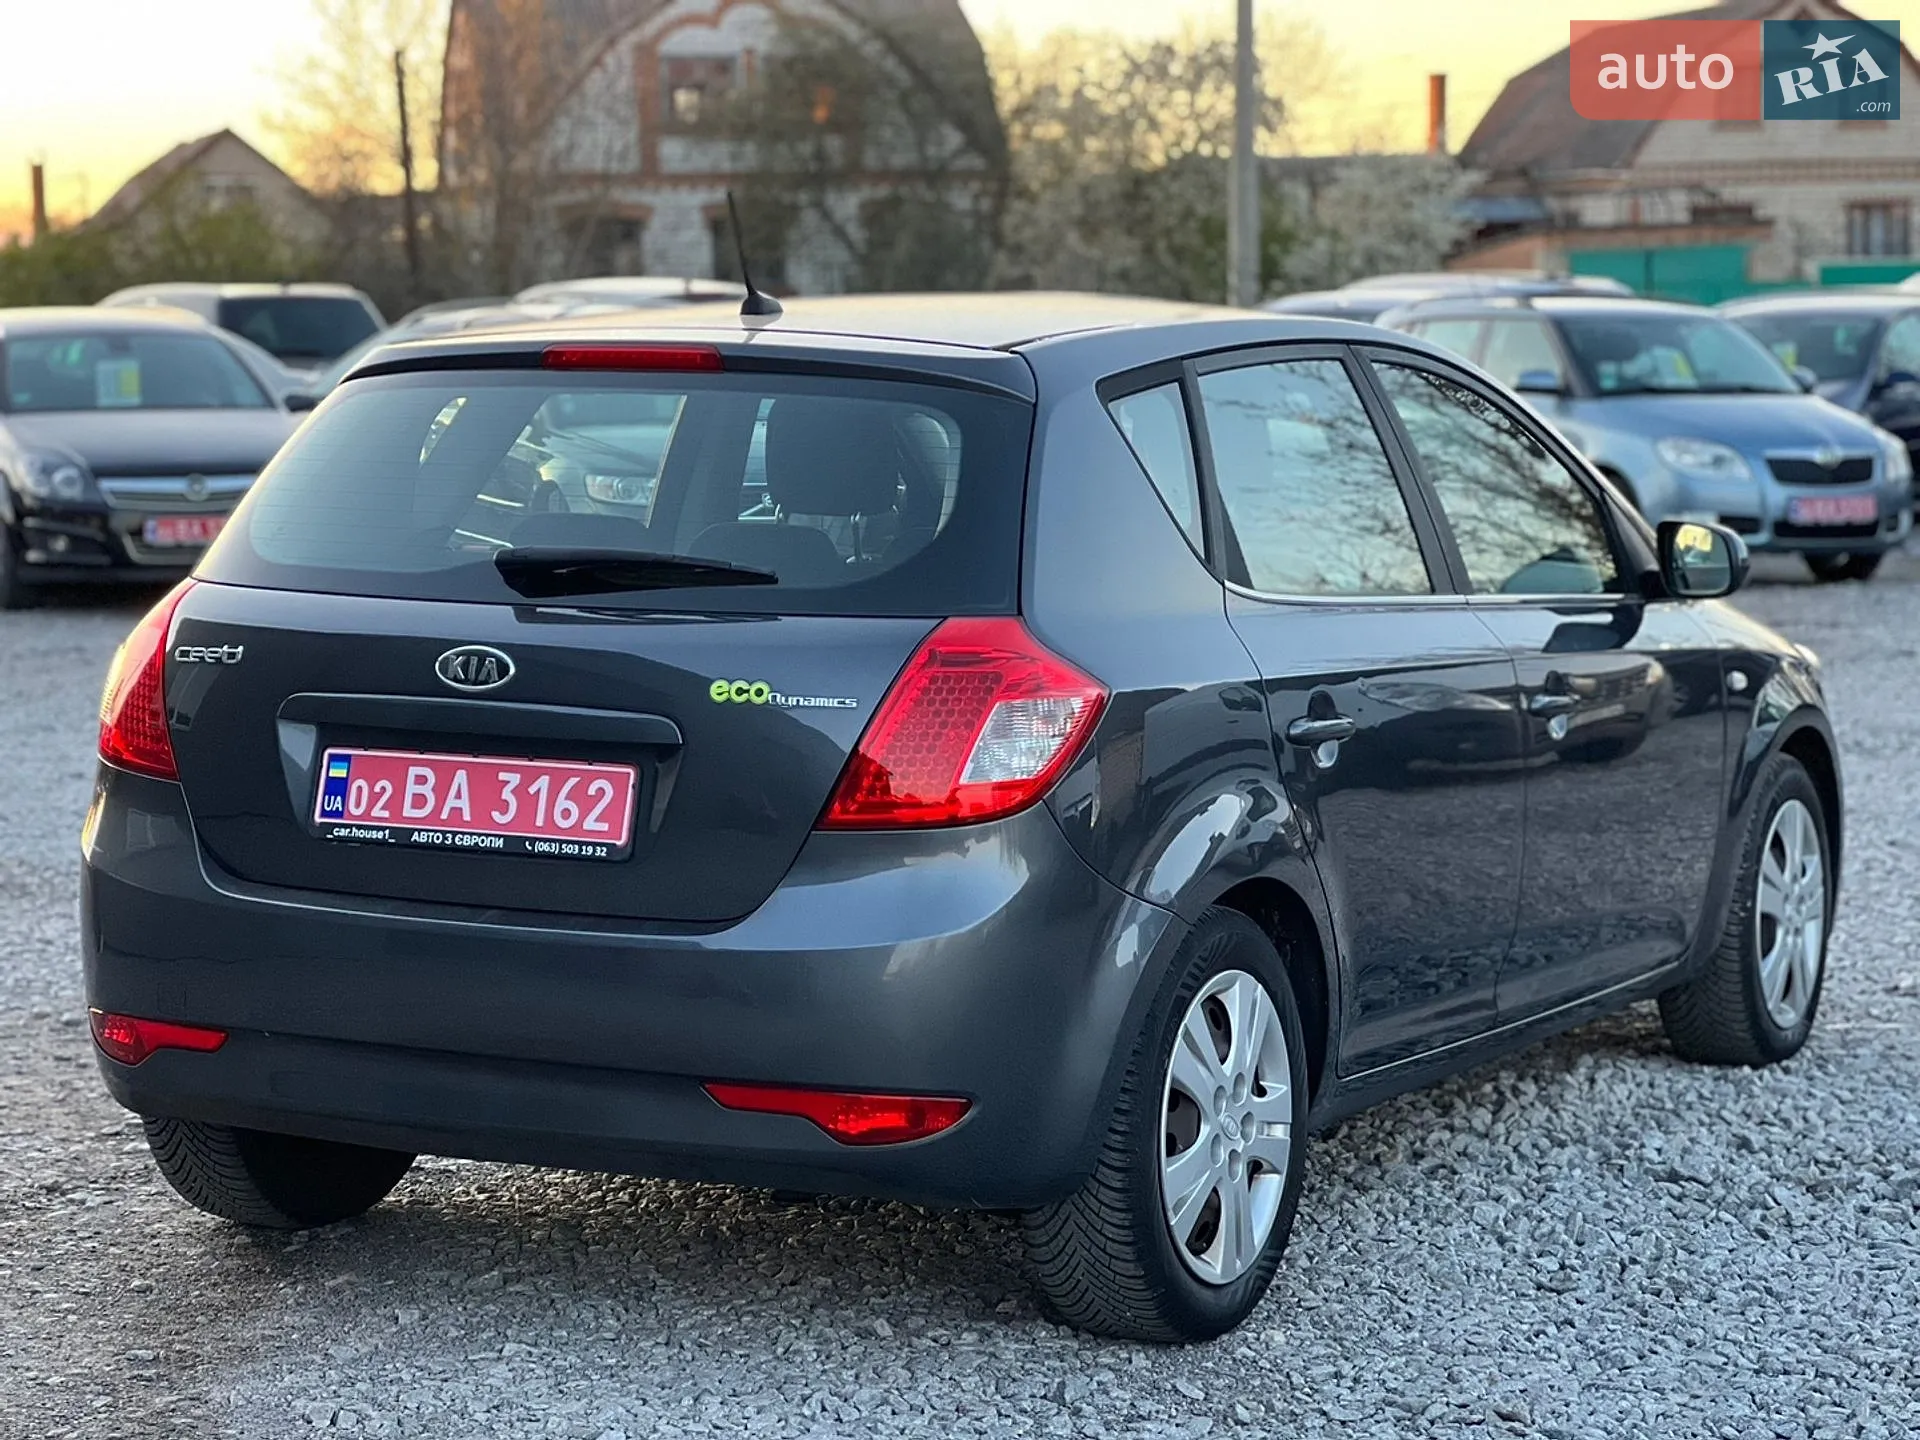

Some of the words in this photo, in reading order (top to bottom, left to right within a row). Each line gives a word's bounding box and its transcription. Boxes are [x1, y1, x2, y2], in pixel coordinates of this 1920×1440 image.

[447, 654, 499, 683] KIA
[323, 794, 343, 813] UA
[348, 778, 394, 818] 02
[402, 766, 471, 822] BA
[490, 771, 615, 832] 3162
[410, 831, 443, 844] АВТО
[454, 834, 504, 849] ЄВРОПИ
[534, 841, 559, 855] (063)
[561, 843, 579, 855] 503
[581, 844, 593, 856] 19
[594, 846, 607, 857] 32
